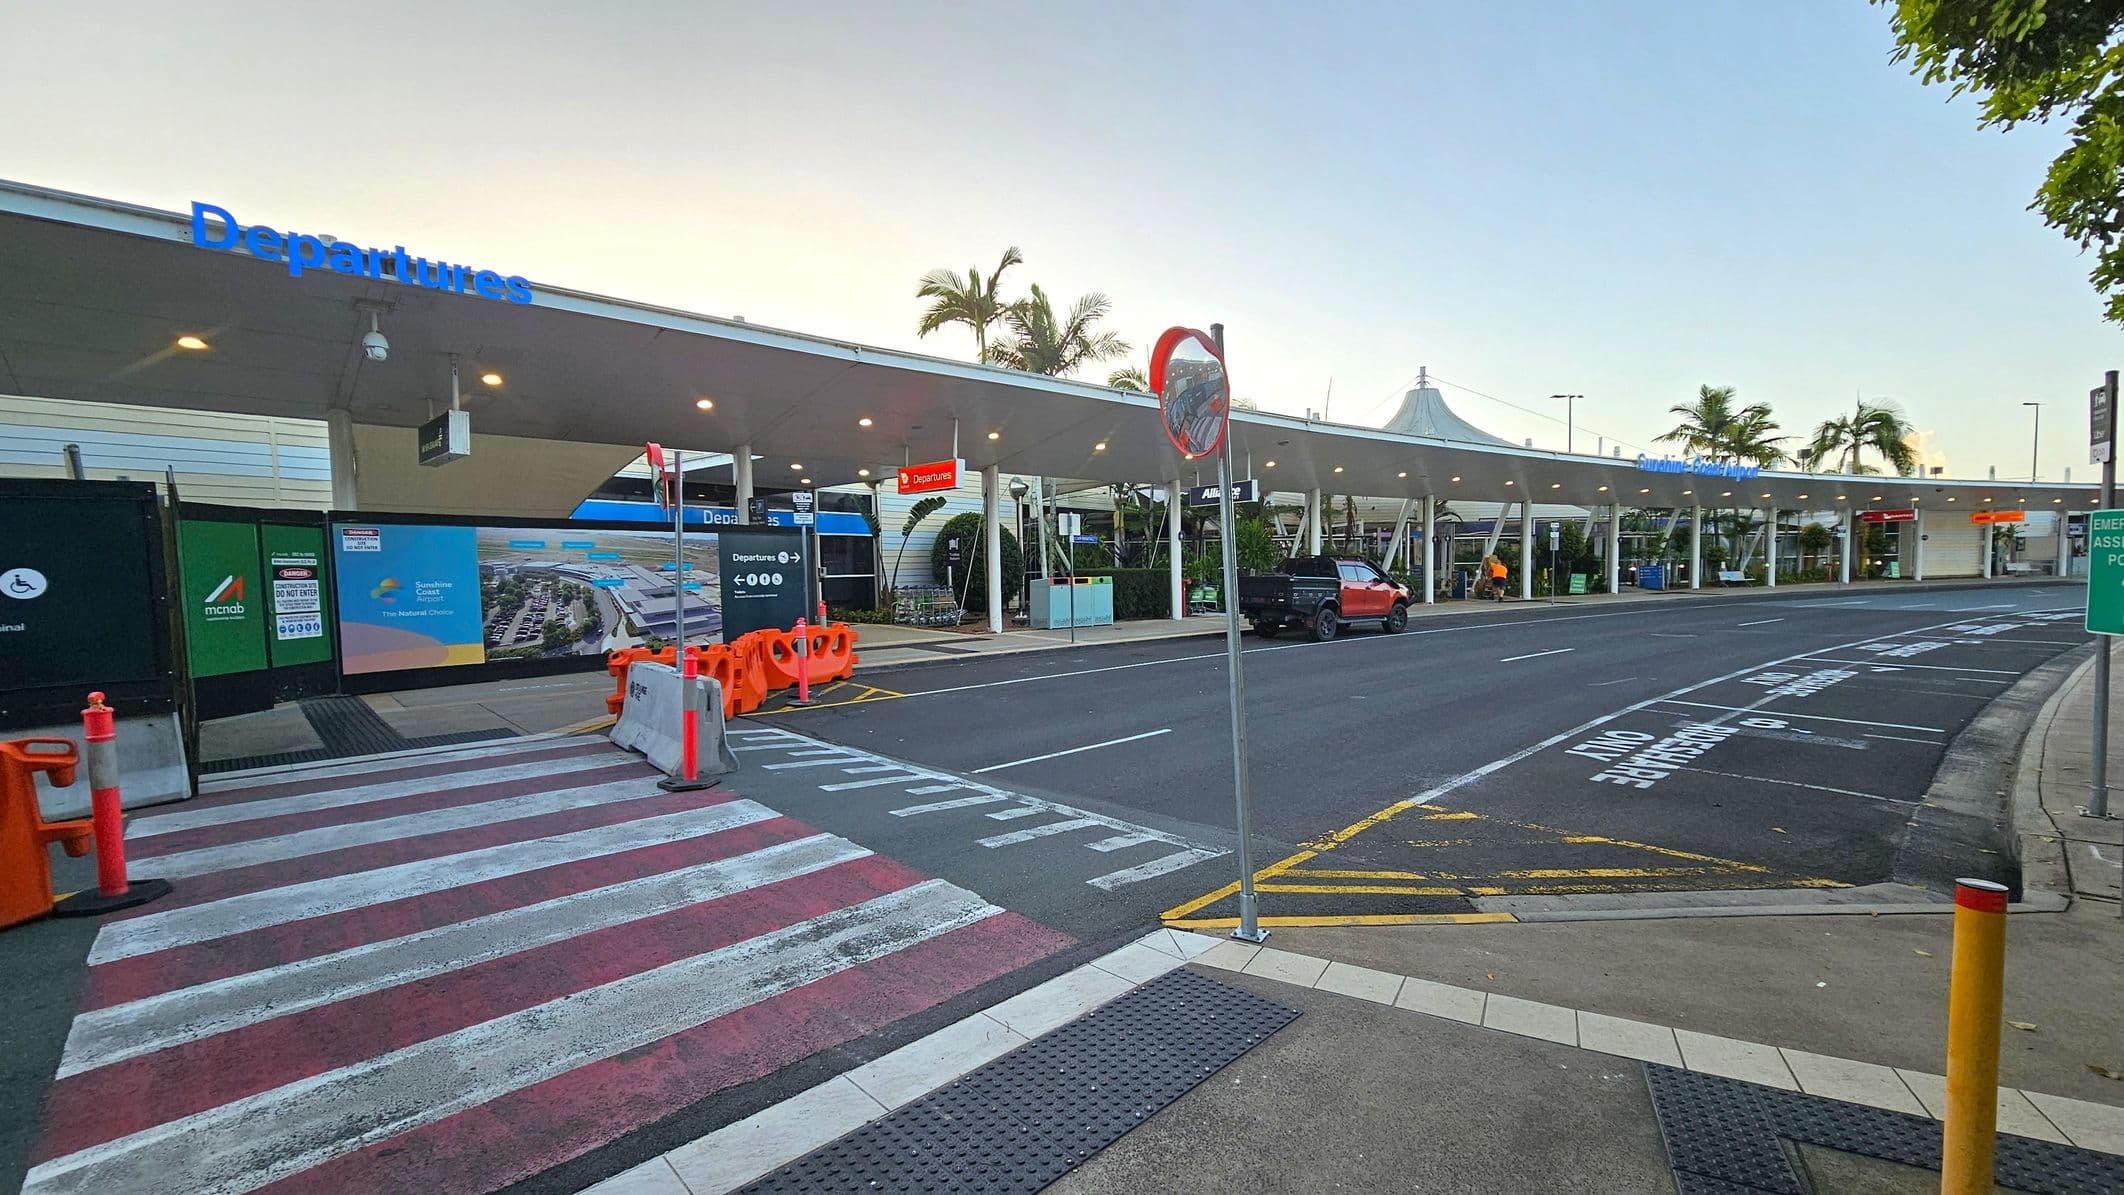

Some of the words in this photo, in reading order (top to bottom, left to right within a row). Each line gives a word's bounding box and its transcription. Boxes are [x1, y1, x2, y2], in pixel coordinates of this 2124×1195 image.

[190, 200, 533, 305] Departures
[913, 472, 952, 485] Departures
[732, 552, 777, 563] Departures
[276, 590, 285, 598] DO
[286, 589, 298, 597] NOT
[300, 589, 318, 597] ENTER
[416, 595, 445, 603] Airport
[205, 601, 245, 616] mcnab
[1564, 729, 1656, 762] ONLY
[1588, 722, 1741, 790] RIDESHARE
